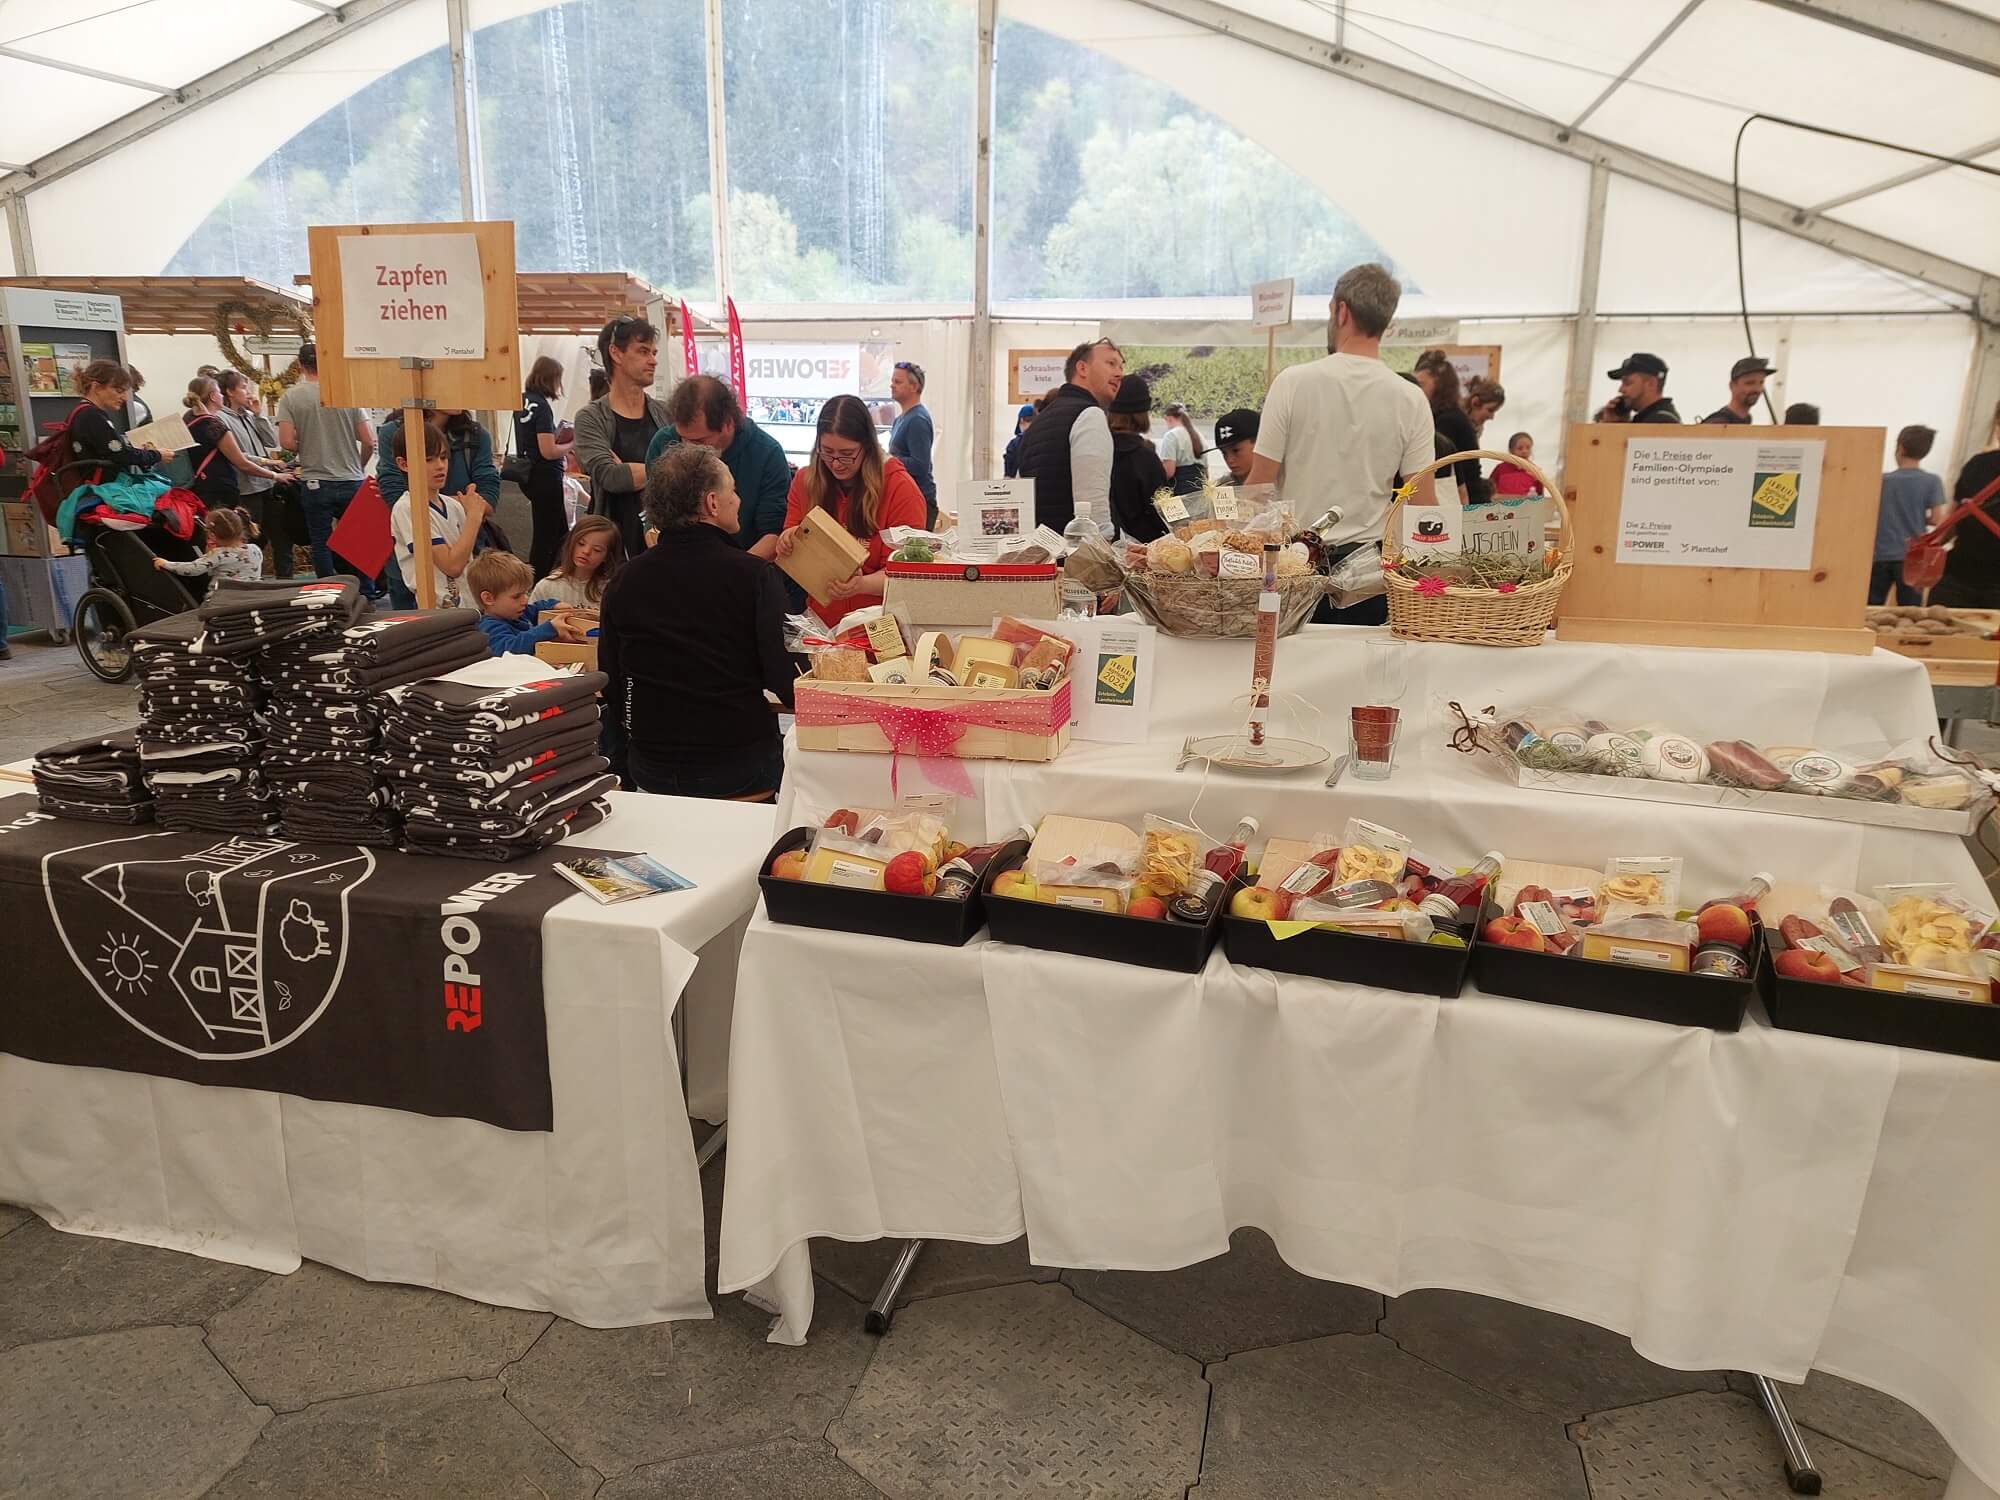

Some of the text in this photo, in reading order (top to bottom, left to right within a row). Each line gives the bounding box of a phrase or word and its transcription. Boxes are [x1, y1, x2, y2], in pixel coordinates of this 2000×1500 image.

[375, 263, 448, 293] Zapfen
[380, 298, 448, 321] ziehen
[1633, 450, 1650, 460] Die
[1662, 450, 1693, 461] Preise
[1695, 451, 1713, 461] der
[1632, 462, 1734, 475] Familien-Olympiade
[1631, 476, 1651, 485] sind
[1653, 476, 1695, 487] gestiftet
[1626, 521, 1638, 529] Die
[1649, 521, 1672, 531] Preise
[1462, 525, 1520, 557] UTSCHEIN
[1691, 545, 1728, 554] Plantahof
[1103, 671, 1126, 689] 2024
[440, 872, 537, 1032] REPOWER
